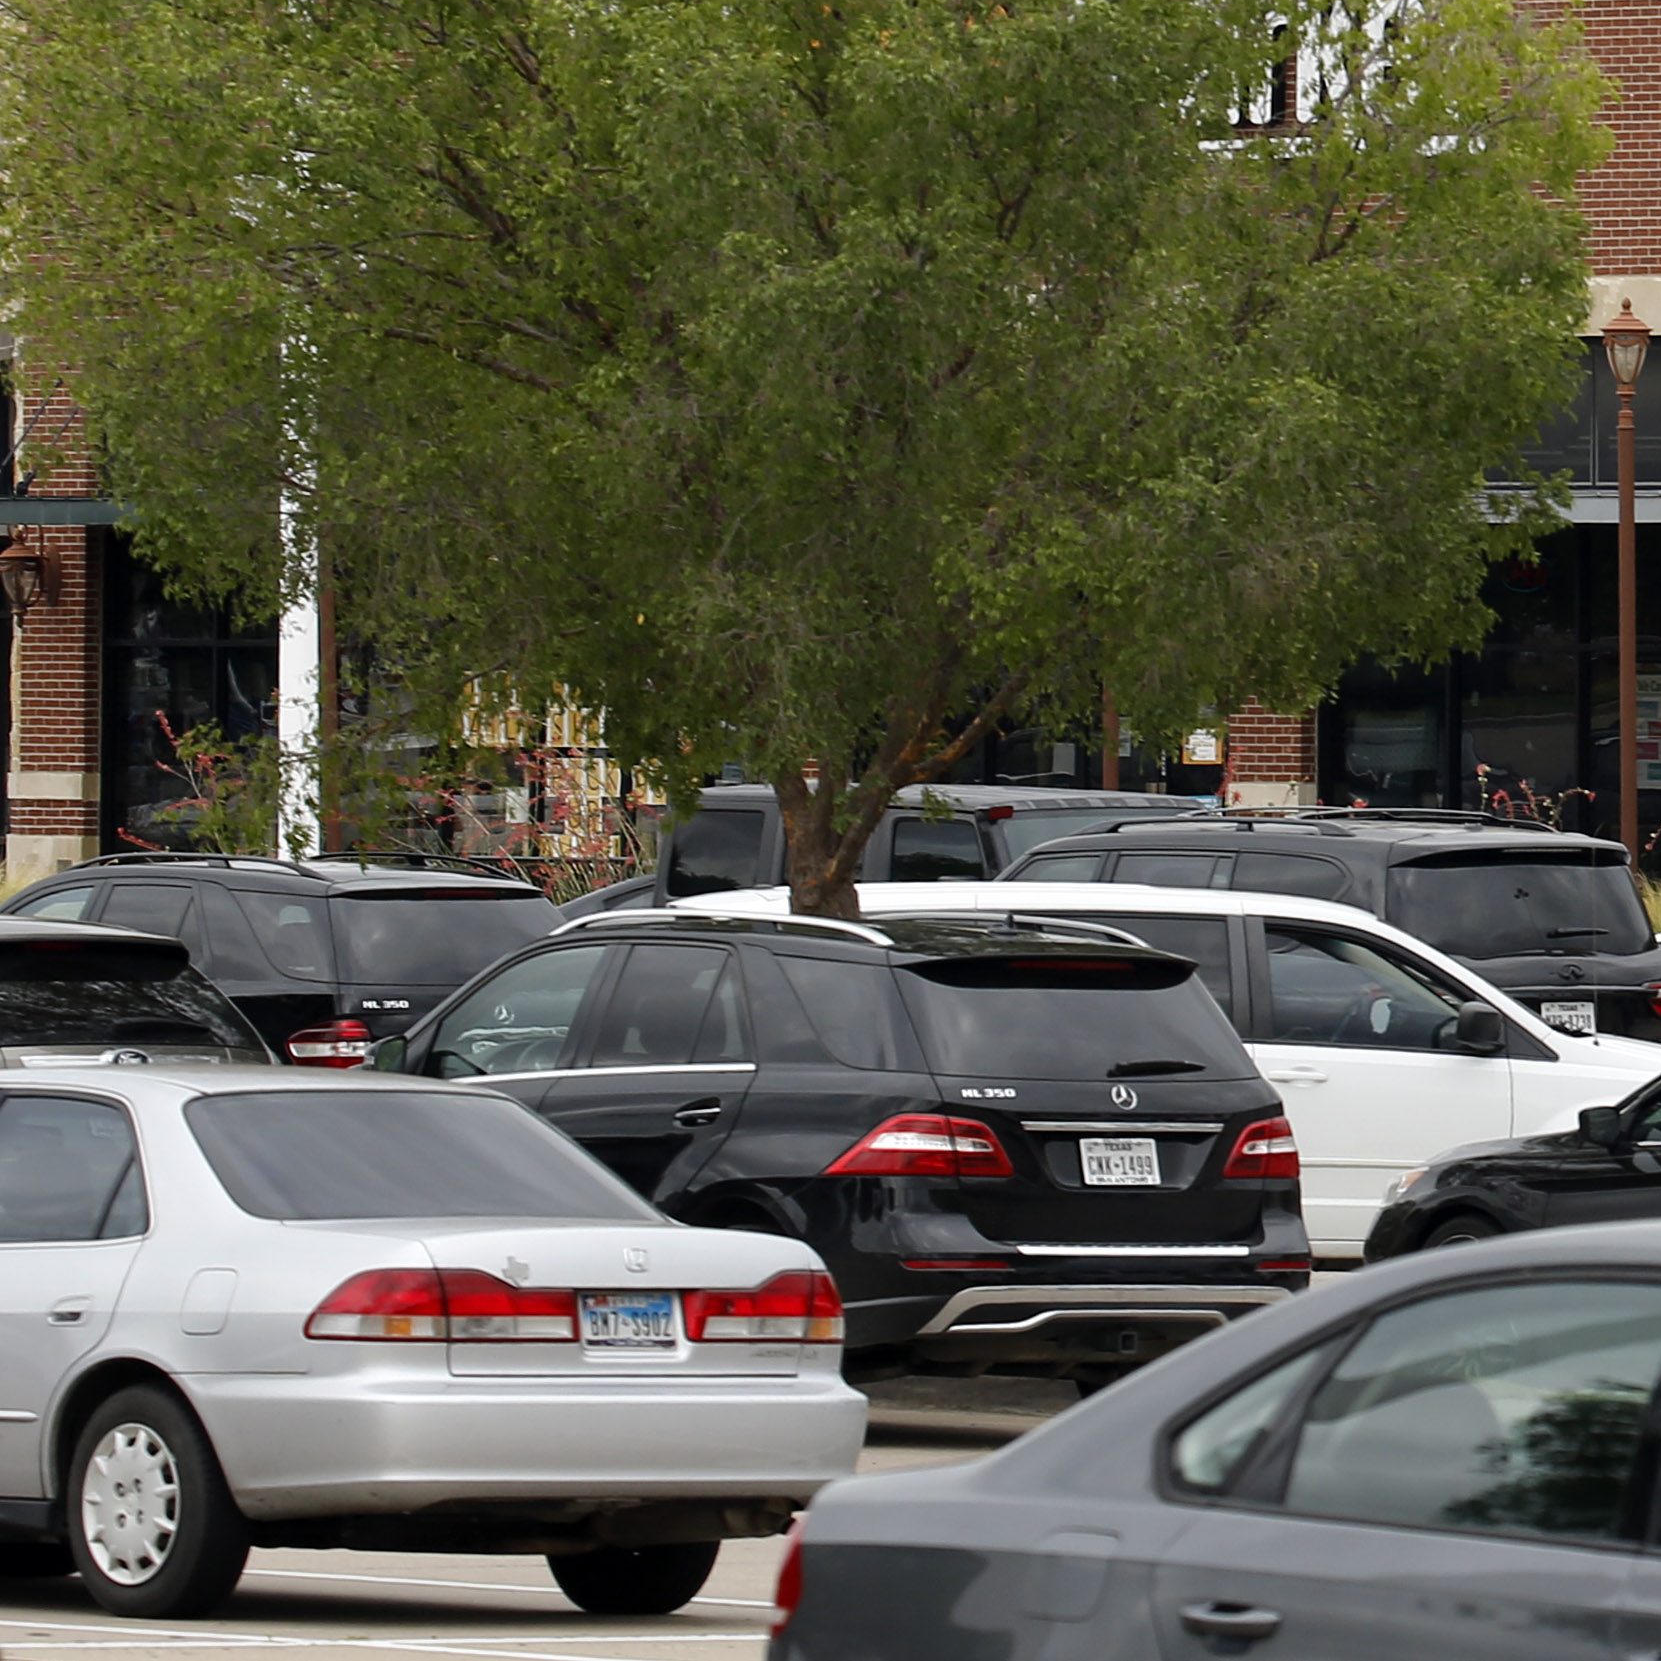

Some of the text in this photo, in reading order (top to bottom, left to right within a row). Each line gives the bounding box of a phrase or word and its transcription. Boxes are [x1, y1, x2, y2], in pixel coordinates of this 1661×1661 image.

[382, 1000, 410, 1009] 350
[983, 1088, 1017, 1098] 350
[1104, 1142, 1132, 1151] TEXAS
